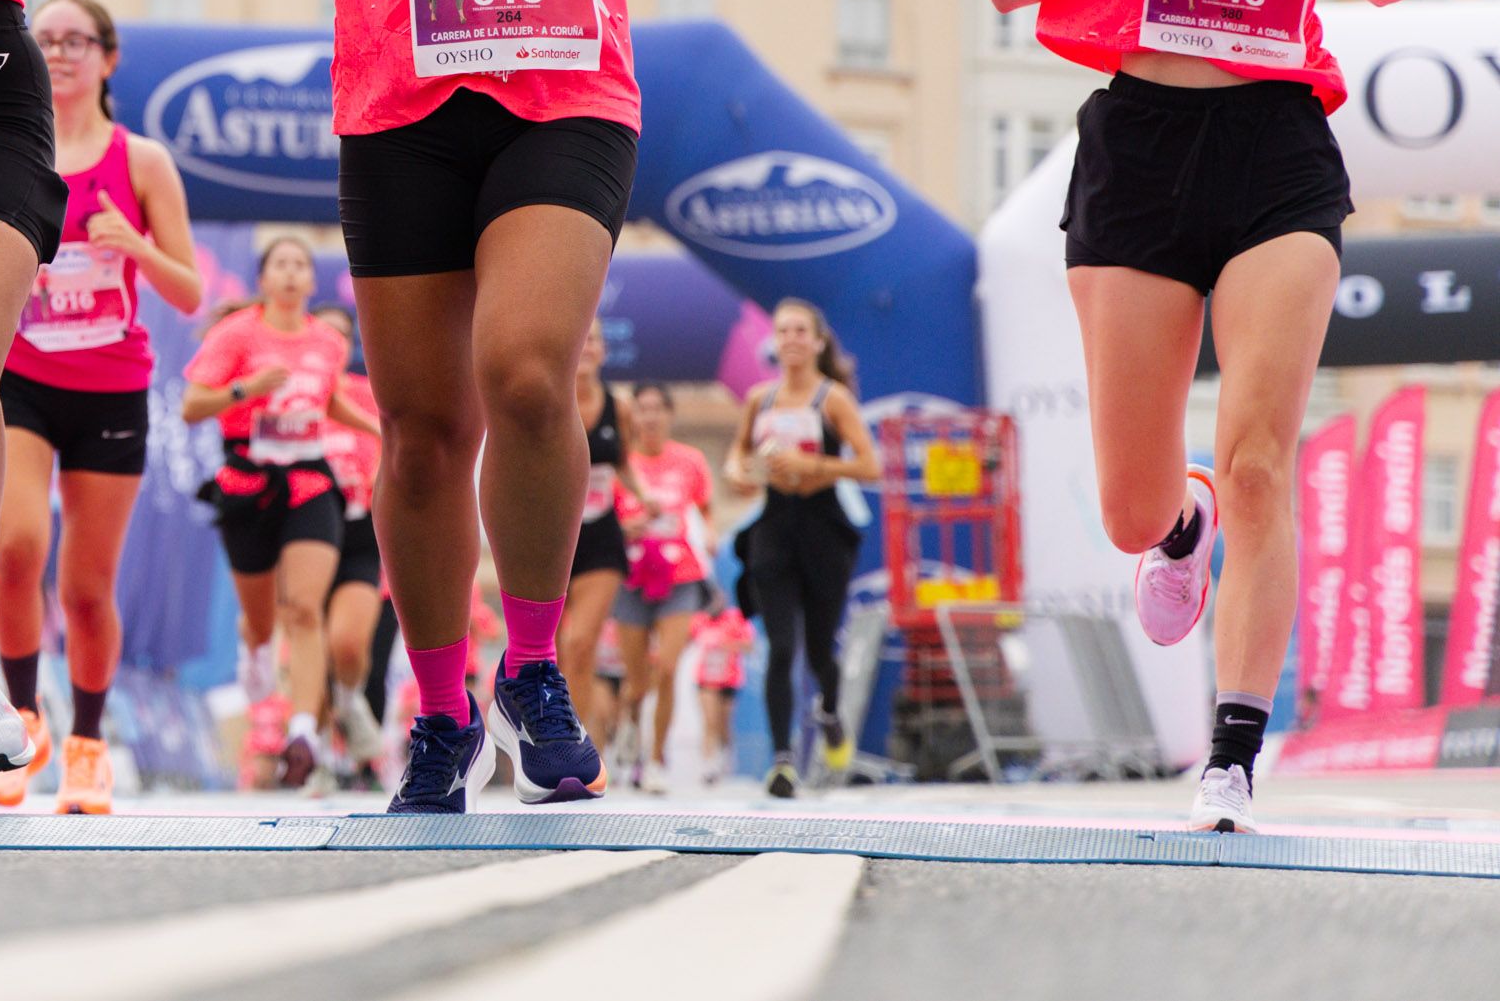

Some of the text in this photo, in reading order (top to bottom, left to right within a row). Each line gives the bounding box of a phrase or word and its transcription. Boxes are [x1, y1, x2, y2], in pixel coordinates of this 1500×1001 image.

[496, 10, 522, 23] 264
[1220, 8, 1243, 20] 380
[431, 29, 471, 42] CARRERA
[474, 28, 485, 38] DE
[487, 27, 500, 37] LA
[502, 26, 533, 37] MUJER
[541, 26, 548, 35] A
[550, 24, 583, 36] CORUÑA
[1159, 13, 1196, 26] CARRERA
[1198, 18, 1210, 28] DE
[1211, 20, 1221, 29] LA
[1223, 22, 1250, 33] MUJER
[1257, 27, 1263, 35] A
[1160, 31, 1213, 49] OYSHO
[436, 47, 581, 65] OYSHO Santander
[51, 291, 96, 312] 016
